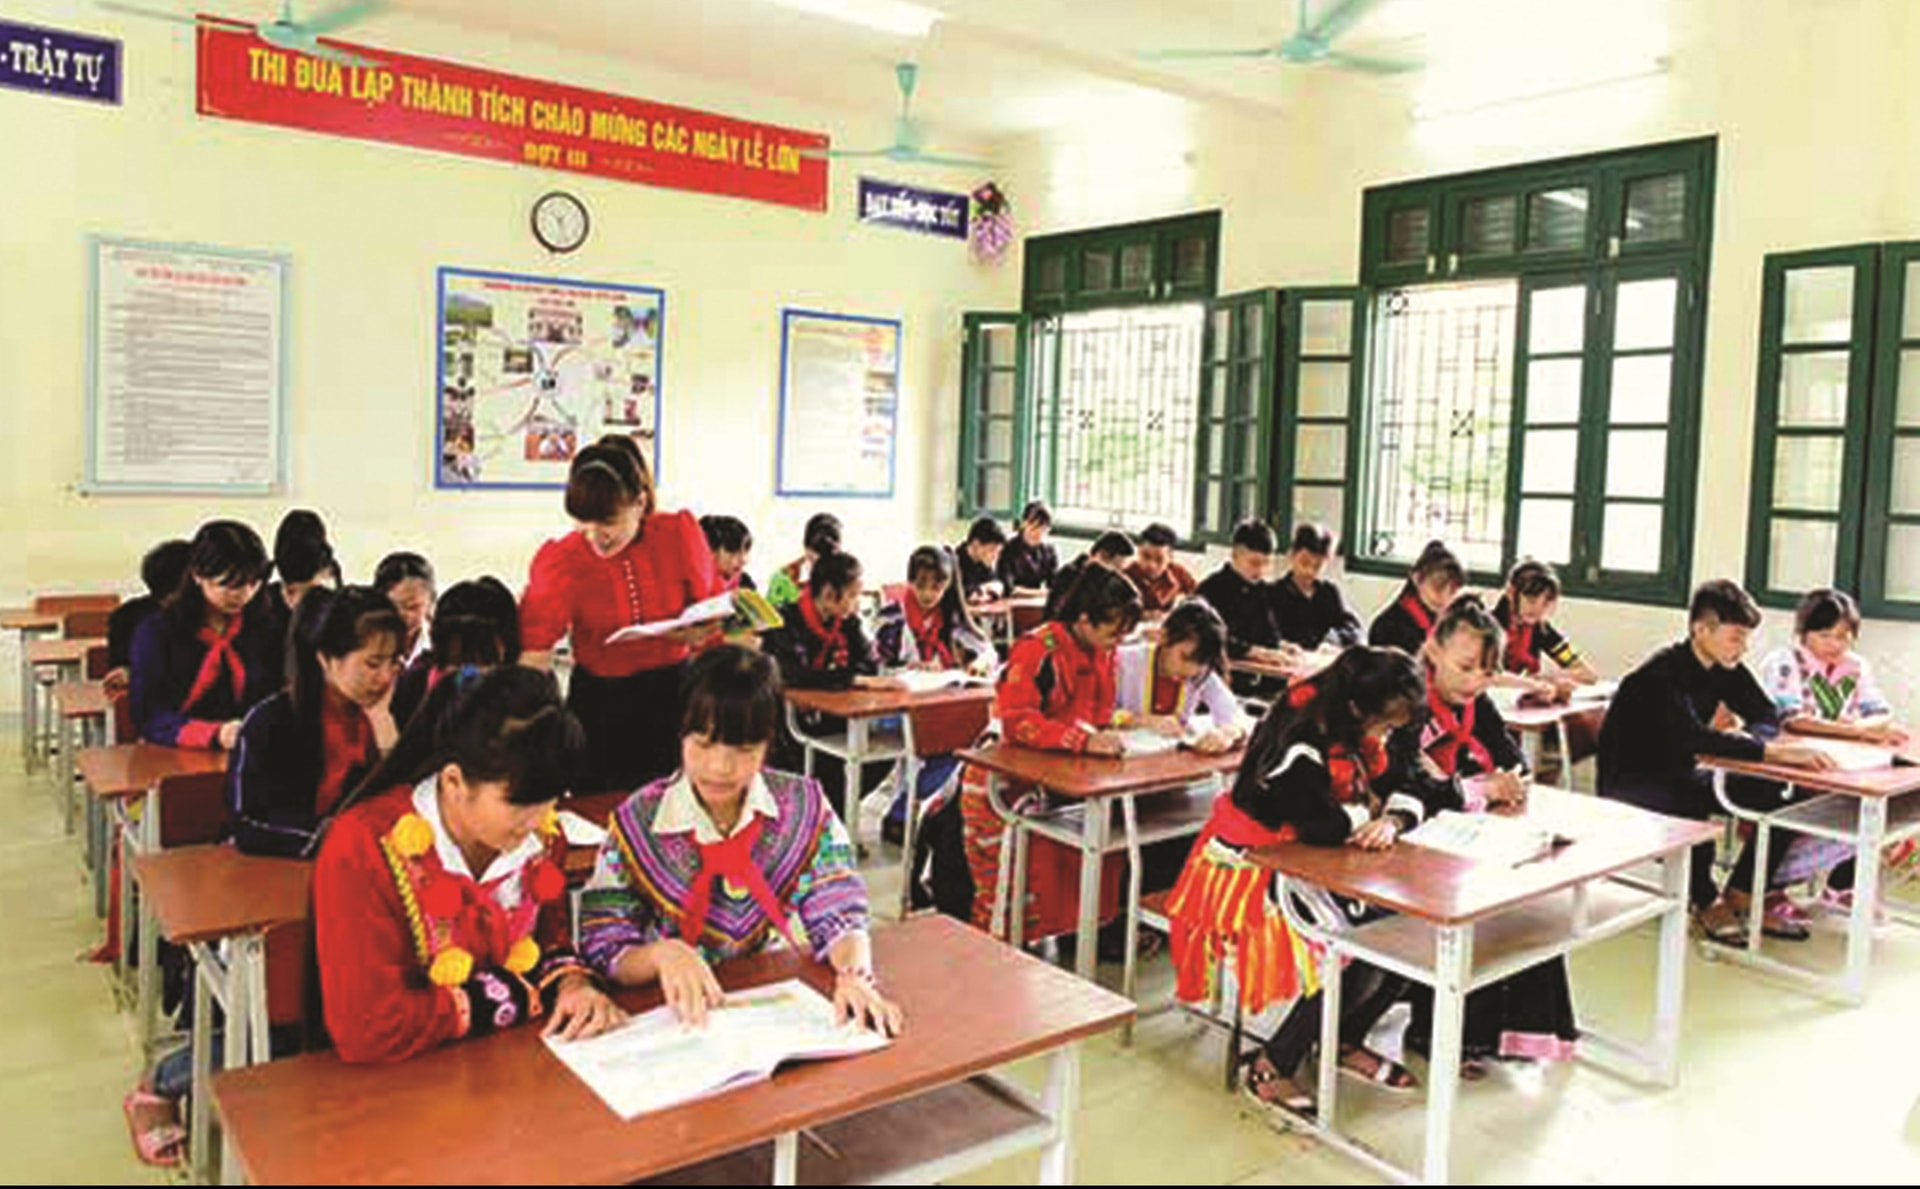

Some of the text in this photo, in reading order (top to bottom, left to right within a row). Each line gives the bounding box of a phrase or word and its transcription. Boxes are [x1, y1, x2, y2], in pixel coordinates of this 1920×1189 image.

[73, 52, 104, 92] TỰ
[248, 47, 287, 86] THI
[295, 56, 342, 97] ĐUA
[401, 72, 472, 117] THÀNH
[478, 84, 525, 126] TÍCH
[530, 97, 585, 136] CHÀO
[590, 106, 647, 147] MỪNG
[652, 117, 689, 154] CÁC
[692, 128, 741, 163] NGÀY
